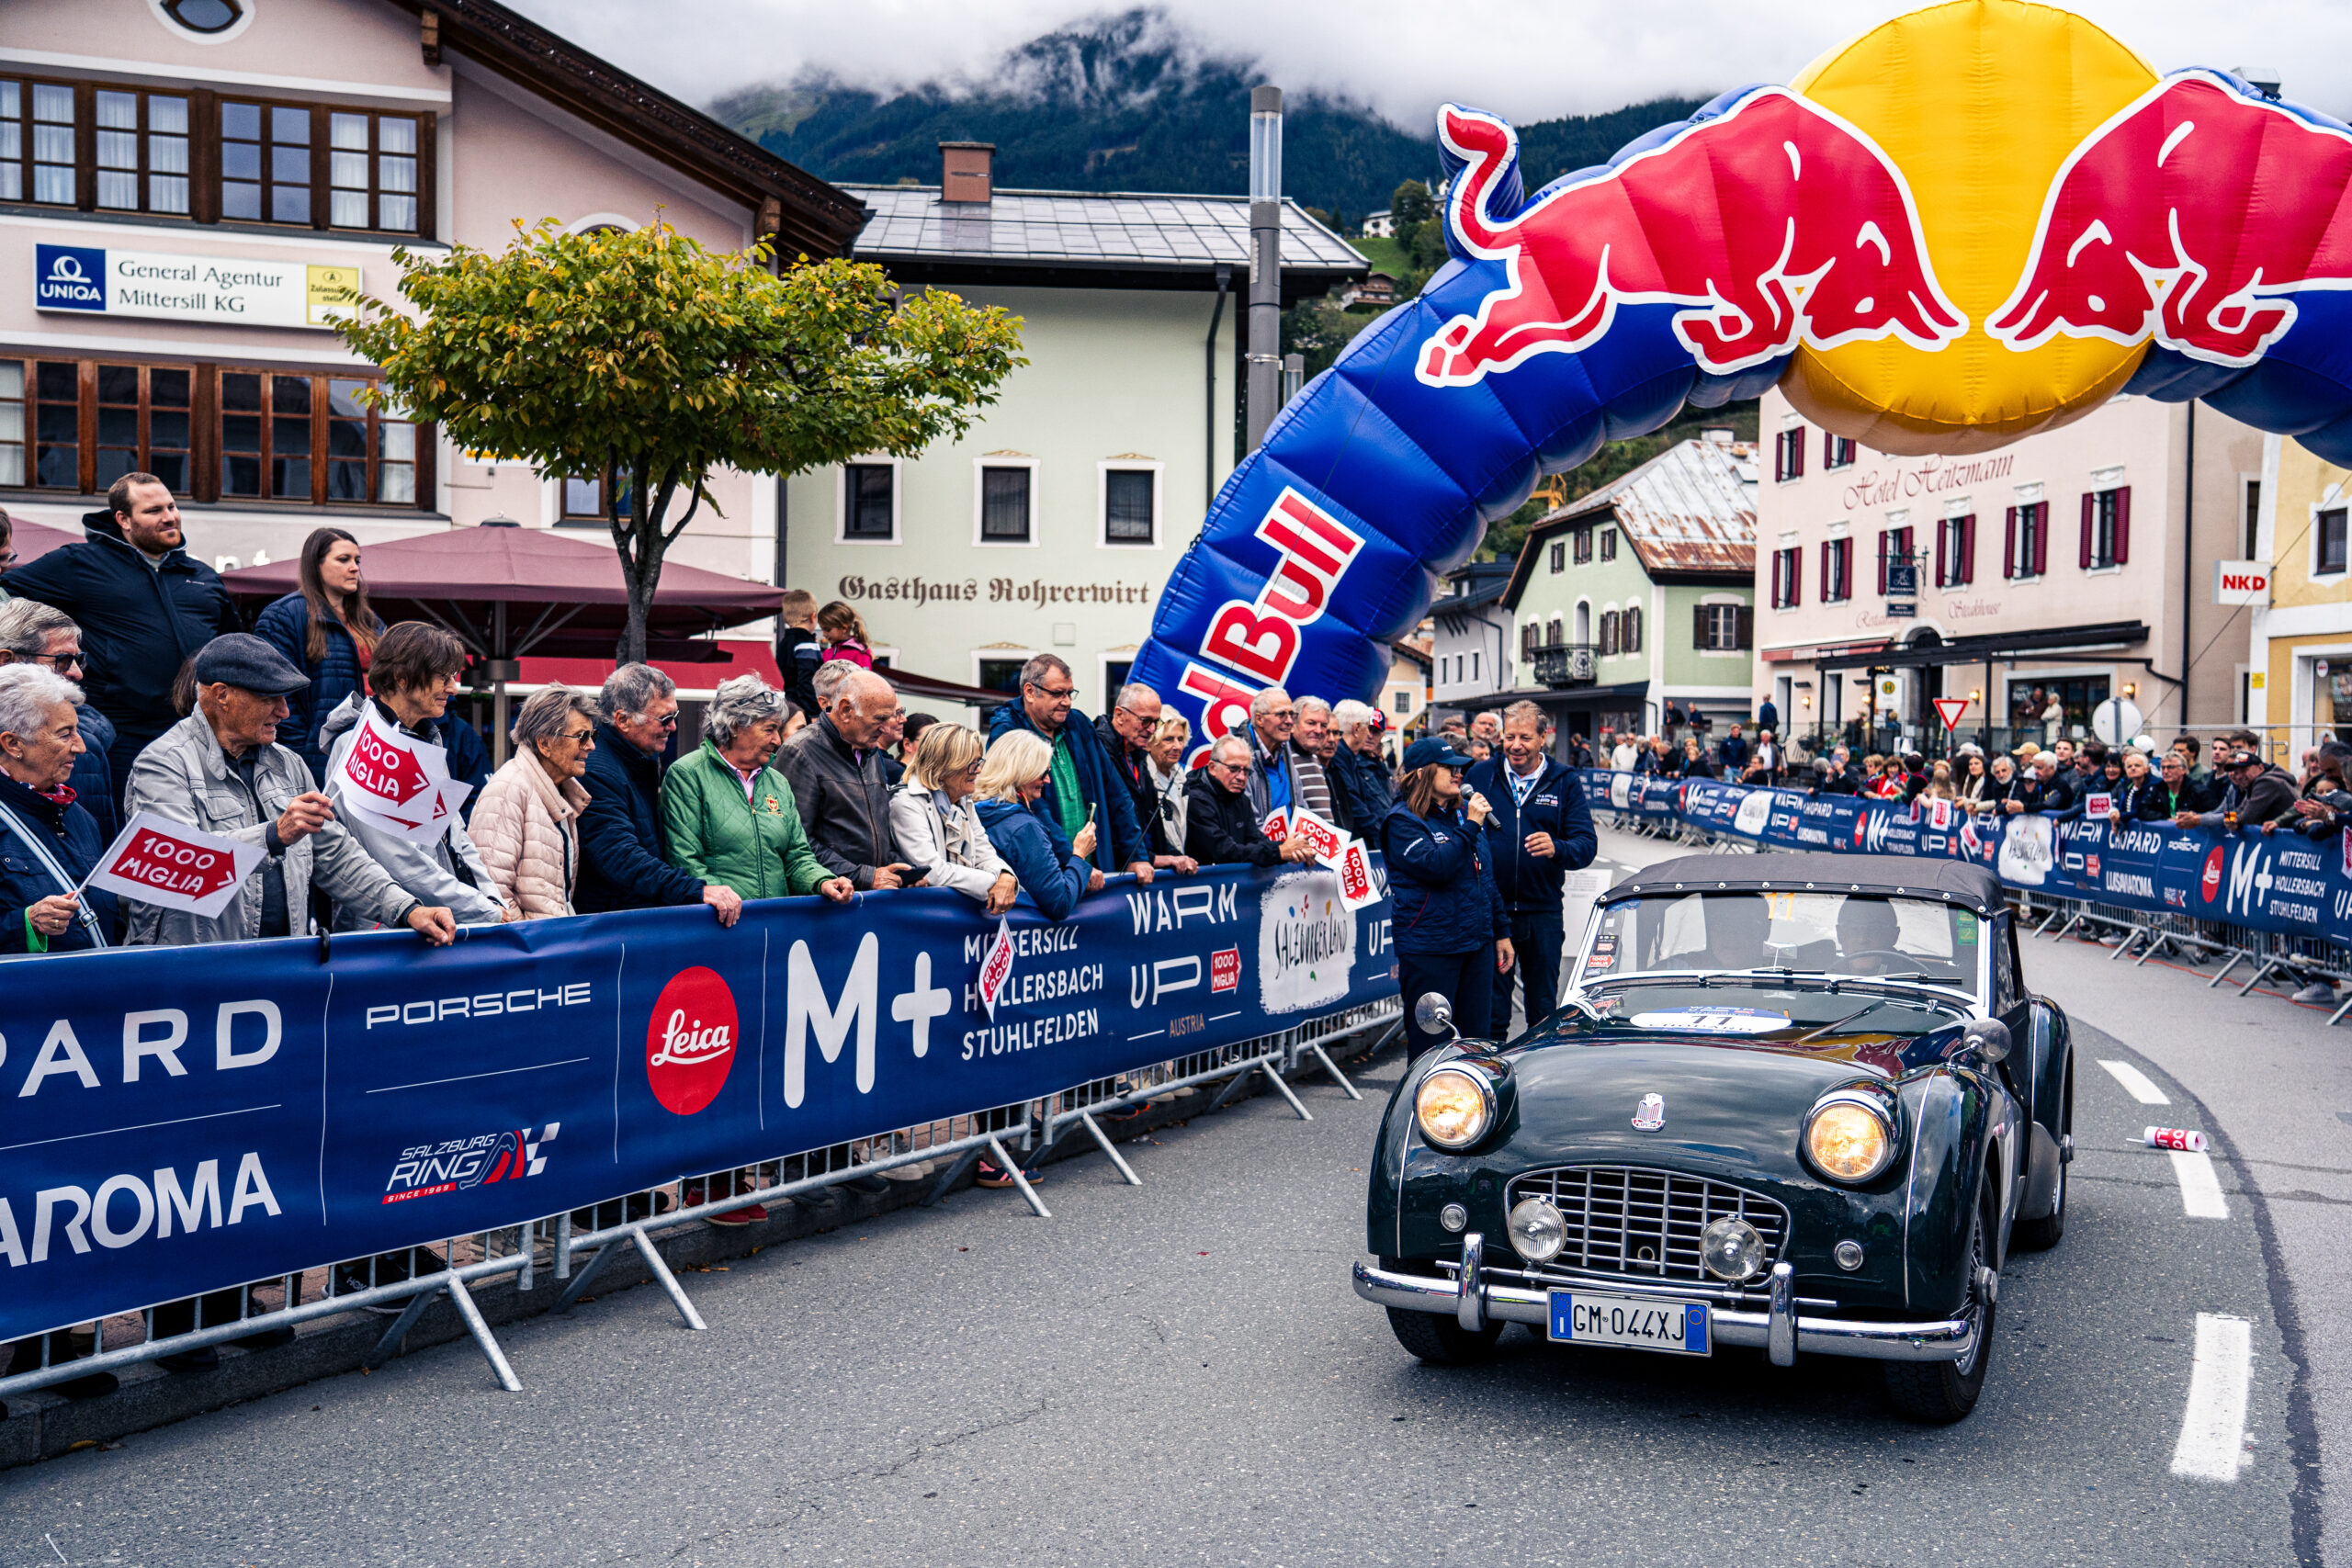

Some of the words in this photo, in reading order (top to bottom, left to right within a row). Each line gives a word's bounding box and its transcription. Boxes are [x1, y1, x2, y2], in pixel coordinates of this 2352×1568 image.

[119, 261, 197, 281] General
[204, 266, 284, 290] Agentur
[40, 283, 102, 302] UNIQA
[119, 288, 206, 310] Mittersill
[215, 295, 244, 313] KG
[1843, 469, 1901, 511] Hotel
[1905, 454, 2014, 498] Heitzmann
[839, 576, 978, 609] Gasthaus
[989, 577, 1150, 610] Rohrerwirt
[1205, 490, 1360, 684] Bull
[2222, 574, 2267, 592] NKD
[360, 728, 401, 771] 1000
[1301, 820, 1332, 843] 1000
[1770, 812, 1790, 828] UP
[2060, 820, 2103, 843] WARM
[143, 837, 216, 870] 1000
[1921, 834, 1947, 852] UP
[2108, 829, 2162, 854] CHOPARD
[2168, 840, 2201, 852] PORSCHE
[1349, 852, 1366, 888] 1000
[2202, 859, 2221, 885] Leica
[2278, 850, 2322, 871] MITTERSILL
[118, 857, 204, 893] MIGLIA
[2274, 874, 2326, 898] HOLLERSBACH
[1125, 882, 1238, 936] WARM
[2269, 898, 2319, 924] STUHLFELDEN
[1214, 953, 1235, 969] 1000
[965, 963, 1103, 1013] HLLERSBACH
[1130, 954, 1202, 1010] UP
[1213, 971, 1236, 988] MIGLIA
[367, 982, 591, 1030] PORSCHE
[650, 1008, 730, 1066] Leica
[961, 1007, 1099, 1061] STUHLFELDEN
[1169, 1012, 1205, 1039] AUSTRIA
[0, 999, 283, 1098] ARD
[399, 1133, 498, 1161] SALZBURG
[386, 1149, 486, 1191] RING
[388, 1190, 420, 1203] SINCE
[424, 1183, 450, 1196] 1969
[1573, 1303, 1602, 1335] GM
[1611, 1307, 1685, 1341] 044XJ
